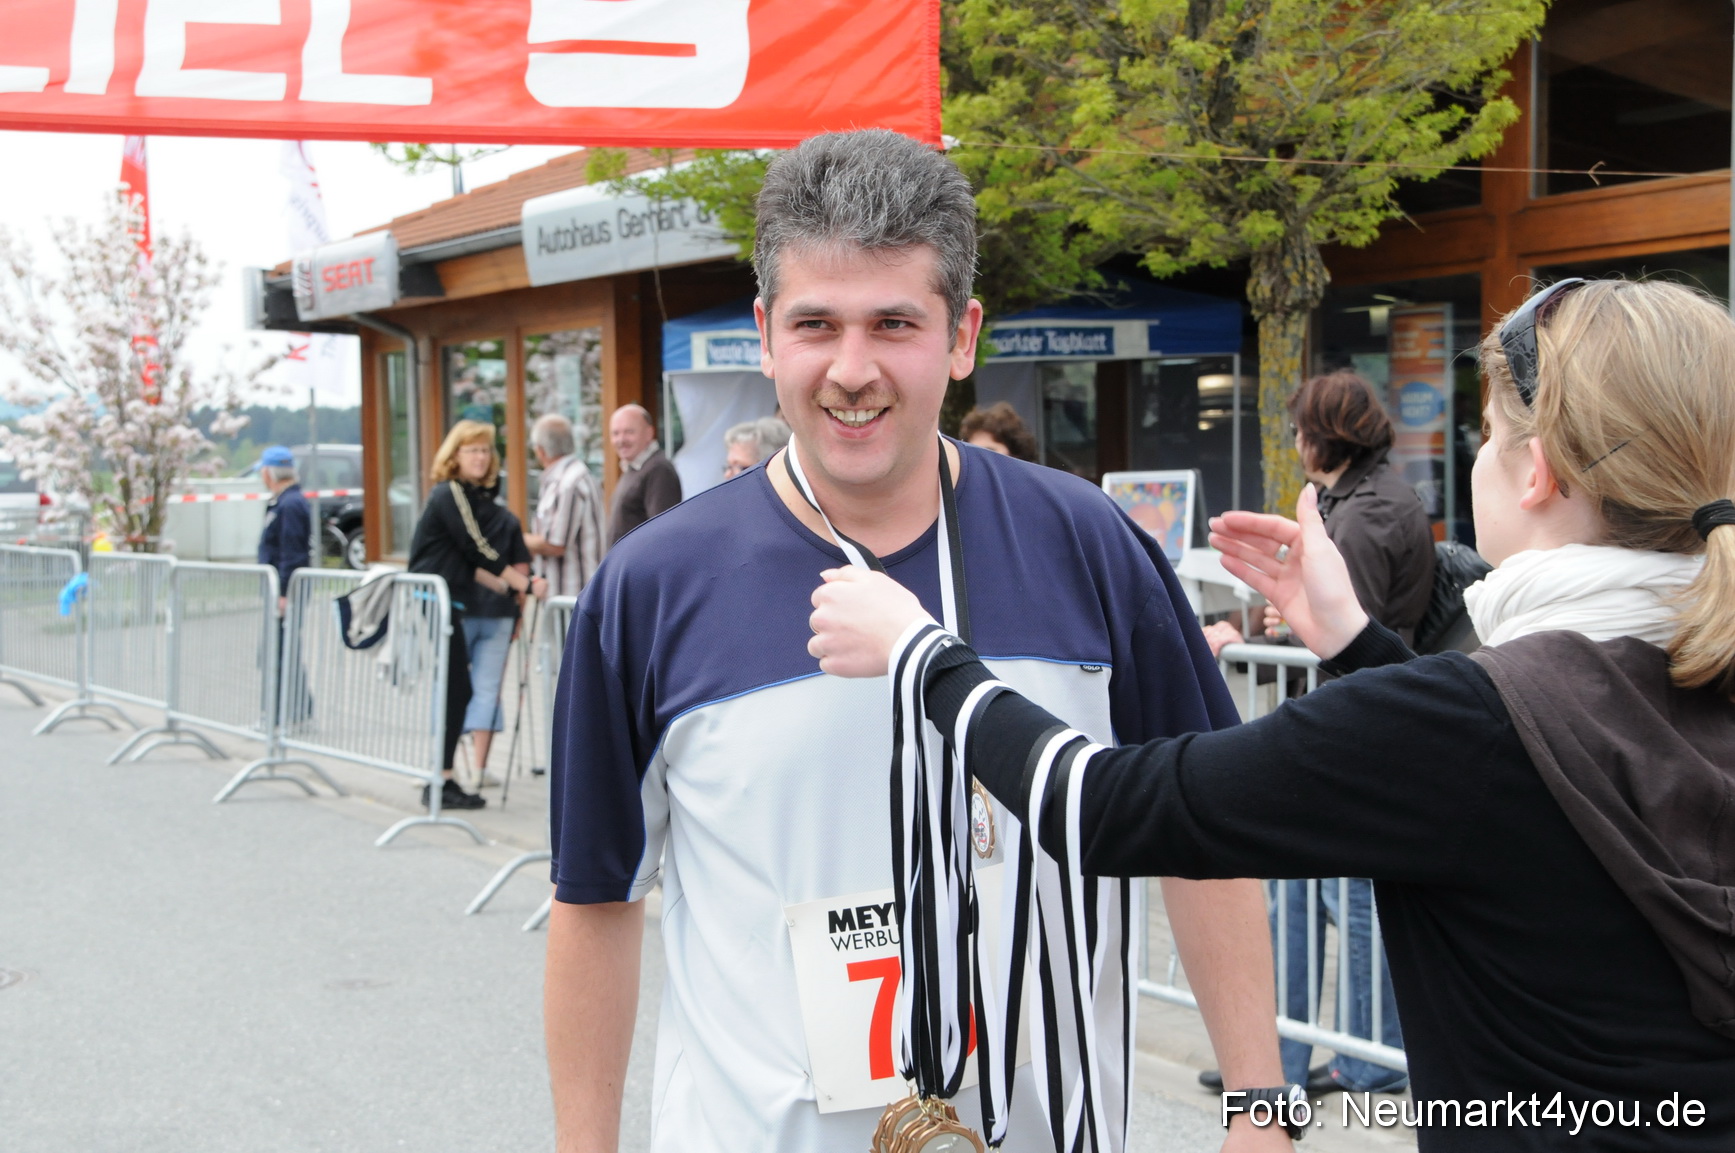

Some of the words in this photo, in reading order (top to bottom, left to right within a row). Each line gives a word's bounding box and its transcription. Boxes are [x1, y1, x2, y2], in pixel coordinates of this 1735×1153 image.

[0, 0, 433, 105] IEL
[537, 218, 612, 256] Autohaus
[321, 257, 376, 293] SEAT
[1045, 330, 1107, 354] Tagblatt
[828, 902, 898, 934] MEY
[830, 929, 901, 952] WERBU
